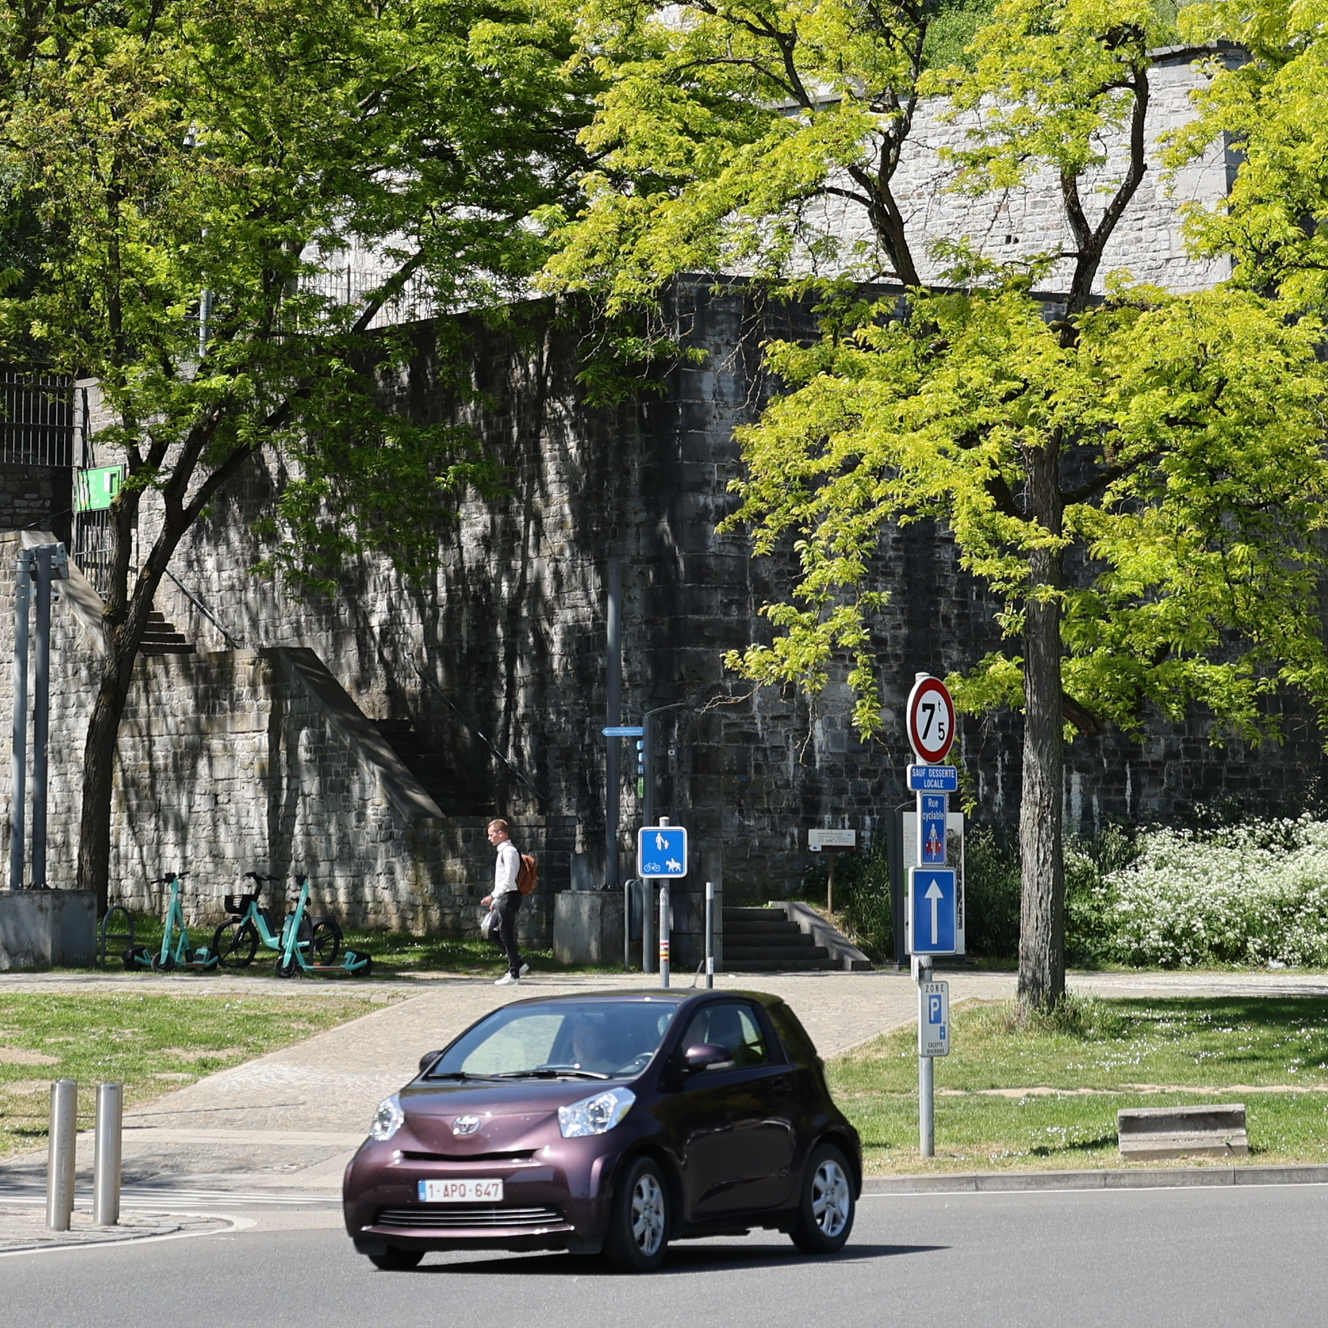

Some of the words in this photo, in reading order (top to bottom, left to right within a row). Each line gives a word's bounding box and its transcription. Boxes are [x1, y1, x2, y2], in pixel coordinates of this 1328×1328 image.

[922, 703, 935, 740] 7
[938, 722, 945, 741] 5
[912, 768, 926, 777] SAUF
[928, 769, 955, 778] DESSERTE
[923, 779, 944, 789] LOCALE
[927, 797, 939, 808] Rue
[922, 810, 944, 823] cyclable
[925, 984, 945, 993] ZONE
